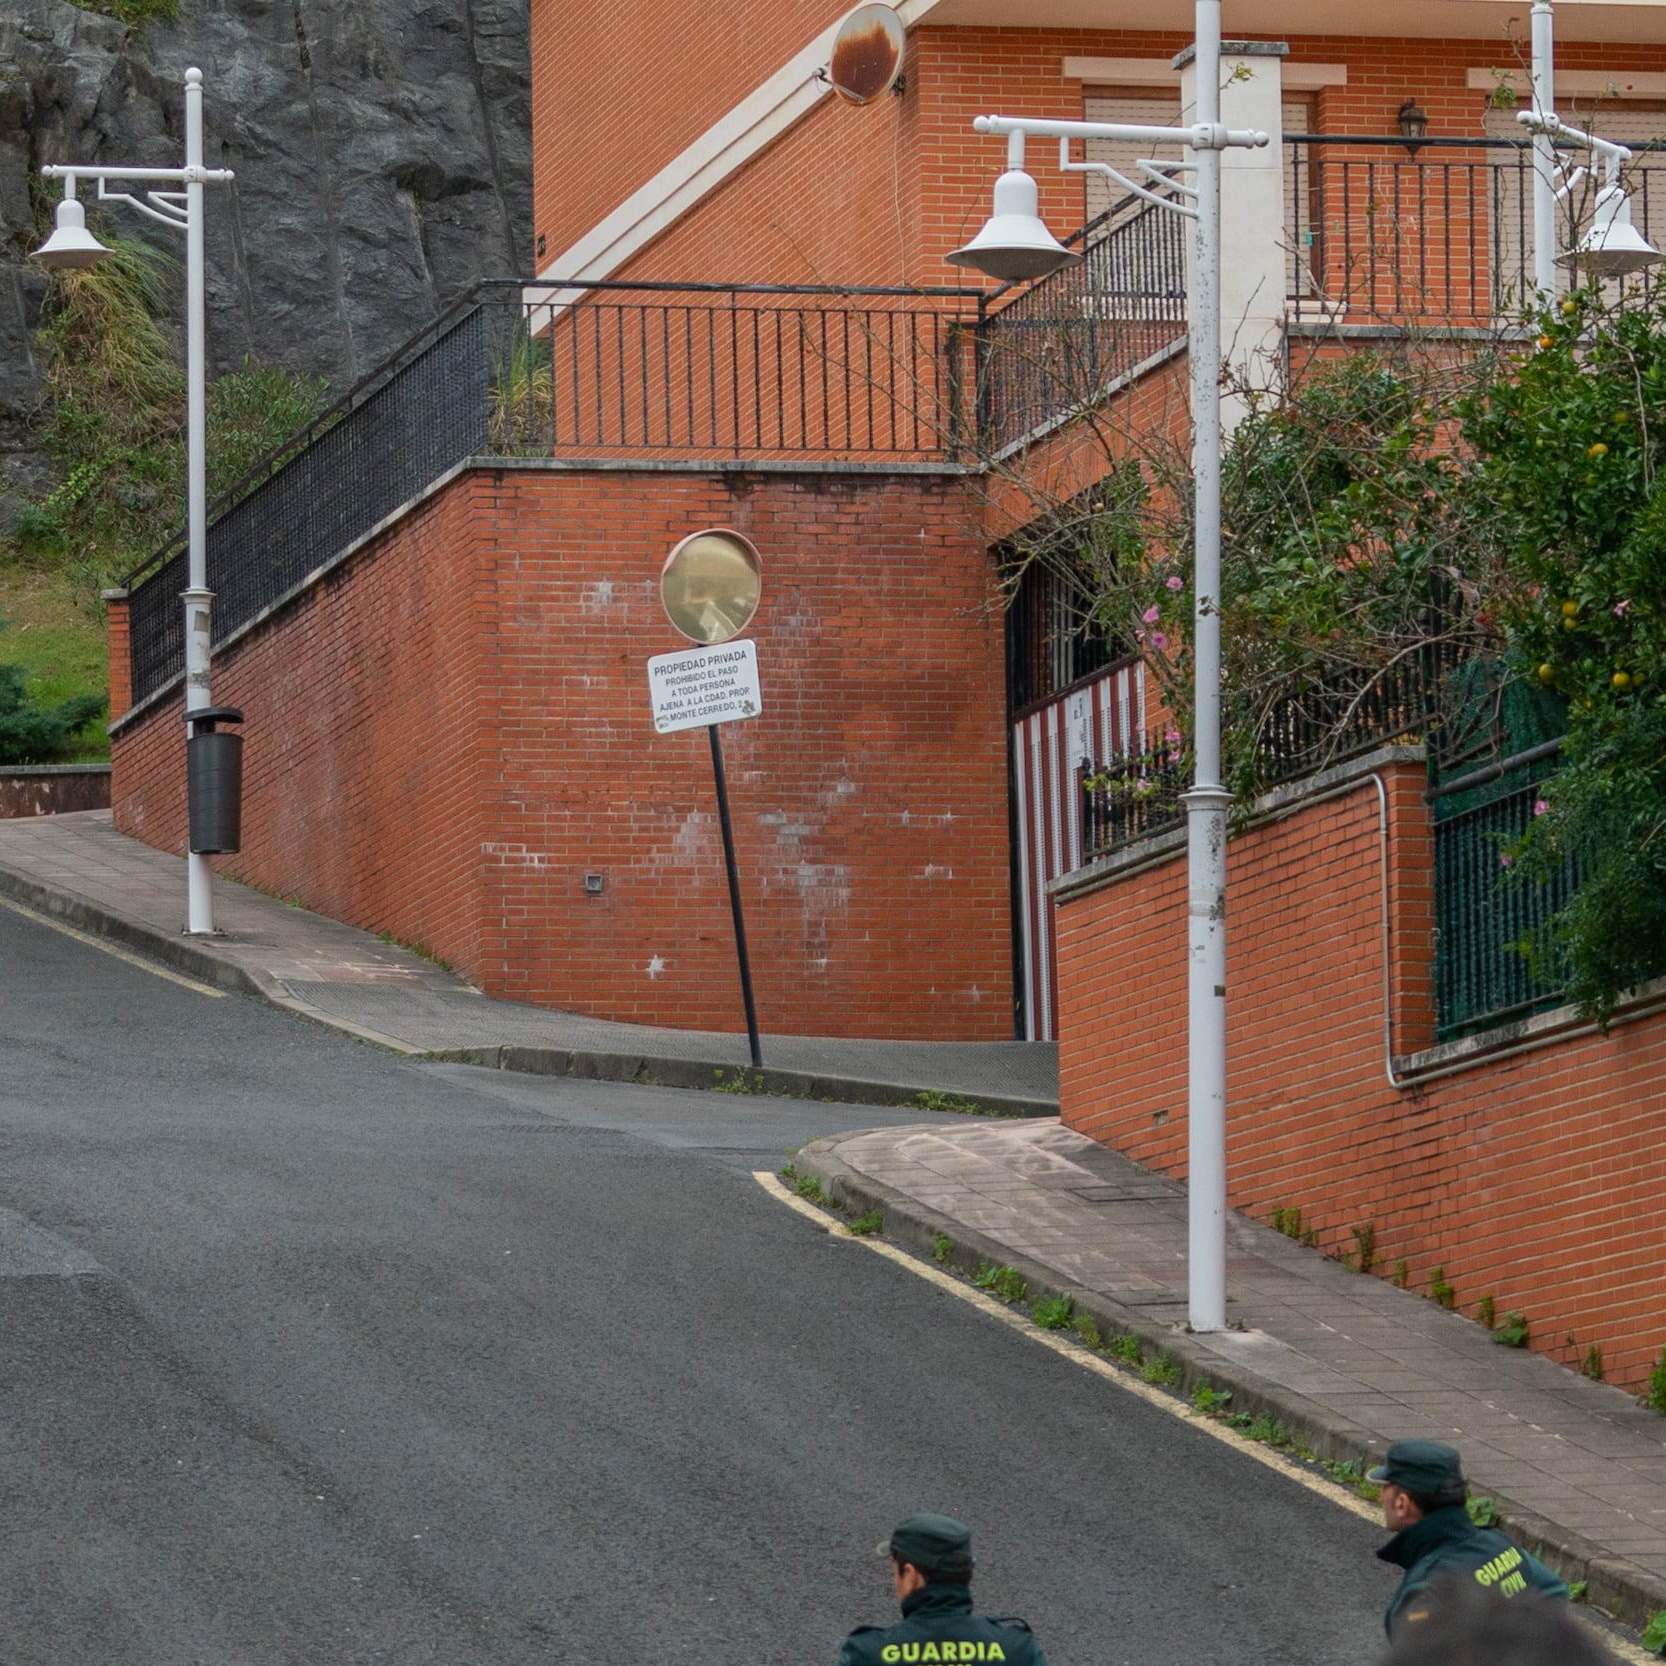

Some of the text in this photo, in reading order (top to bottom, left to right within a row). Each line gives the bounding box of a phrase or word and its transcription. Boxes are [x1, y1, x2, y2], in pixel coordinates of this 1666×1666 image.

[654, 651, 747, 677] PROPIEDAD PRIVADA
[666, 665, 739, 687] PROHIBIDO EL PASO
[678, 685, 699, 696] TODA
[699, 678, 736, 692] PERSONA
[660, 700, 684, 712] AJENA
[693, 697, 703, 706] LA
[670, 710, 697, 721] MONTE
[1474, 1546, 1523, 1587] GUARDIA
[1500, 1570, 1527, 1598] CIVIL
[881, 1641, 1006, 1663] GUARDIA
